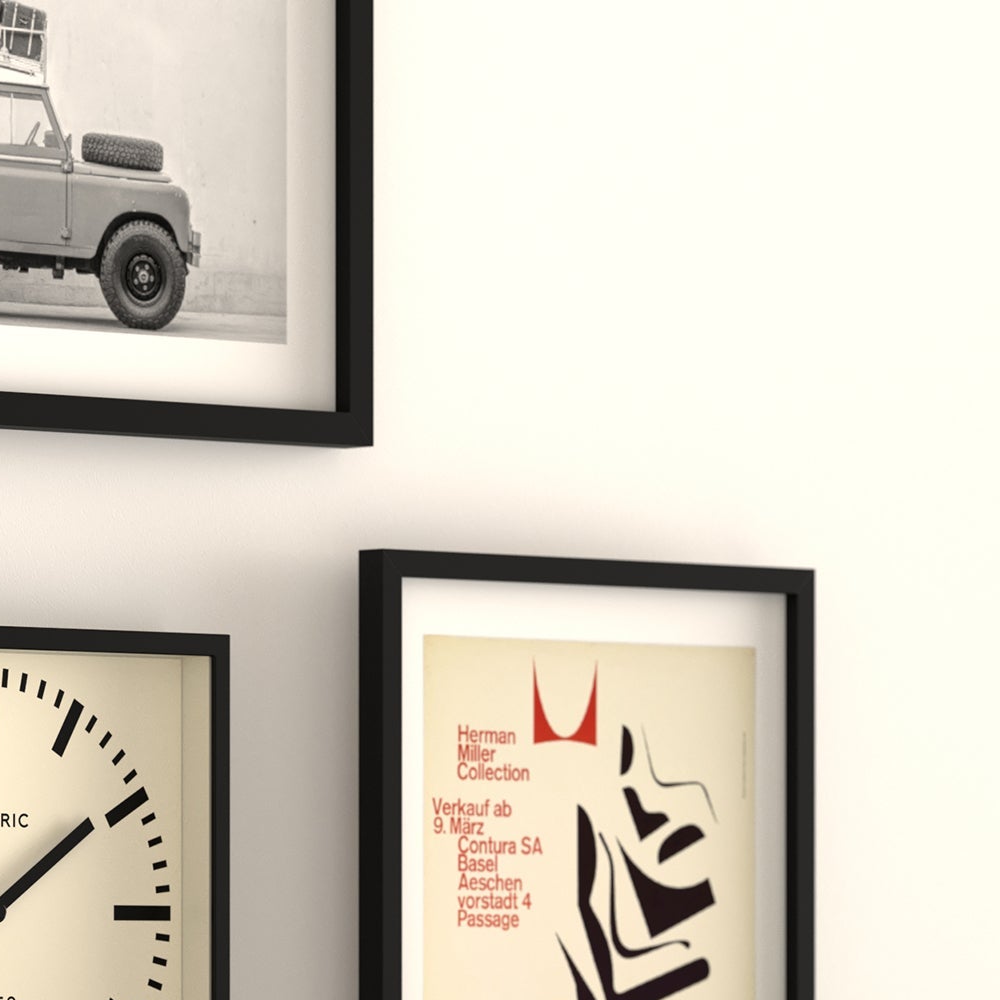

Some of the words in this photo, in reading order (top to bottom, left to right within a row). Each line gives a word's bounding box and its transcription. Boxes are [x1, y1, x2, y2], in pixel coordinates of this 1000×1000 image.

[457, 725, 517, 745] Herman
[457, 744, 496, 762] Miller
[457, 763, 530, 781] Collection
[432, 797, 490, 816] Verkauf
[493, 799, 512, 817] ab
[433, 817, 446, 834] 9.
[450, 817, 484, 835] März
[457, 836, 517, 854] Contura
[521, 837, 543, 855] SA
[457, 855, 498, 872] Basel
[458, 874, 523, 891] Aeschen
[457, 893, 518, 909] vorstadt
[521, 894, 532, 909] 4
[457, 911, 519, 930] Passage
